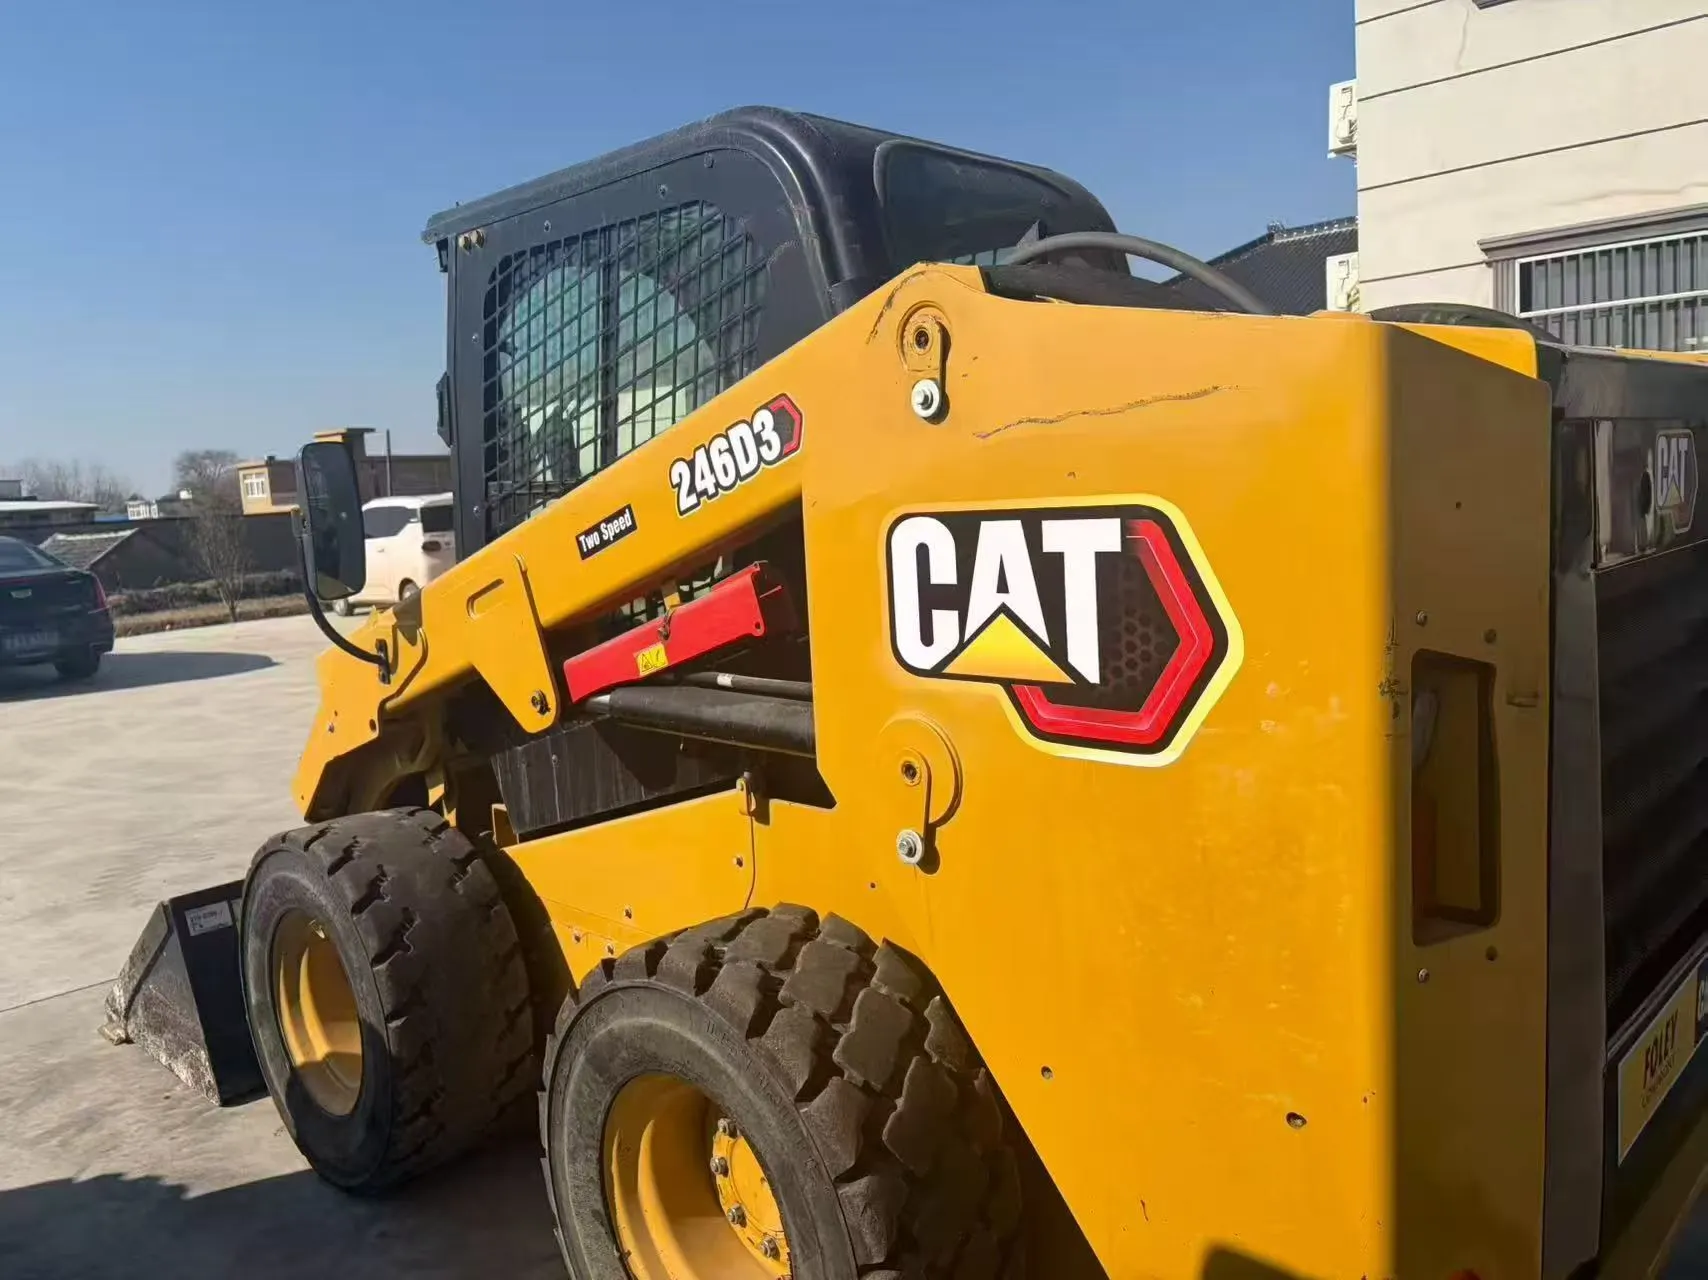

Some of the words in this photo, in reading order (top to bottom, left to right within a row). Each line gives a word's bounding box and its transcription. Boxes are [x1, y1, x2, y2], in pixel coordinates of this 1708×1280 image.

[670, 408, 782, 513] 246D3
[1657, 435, 1689, 506] CAT
[579, 534, 600, 552] Two
[600, 508, 632, 541] Speed
[890, 516, 1122, 684] CAT
[1643, 1008, 1679, 1090] FOLEY
